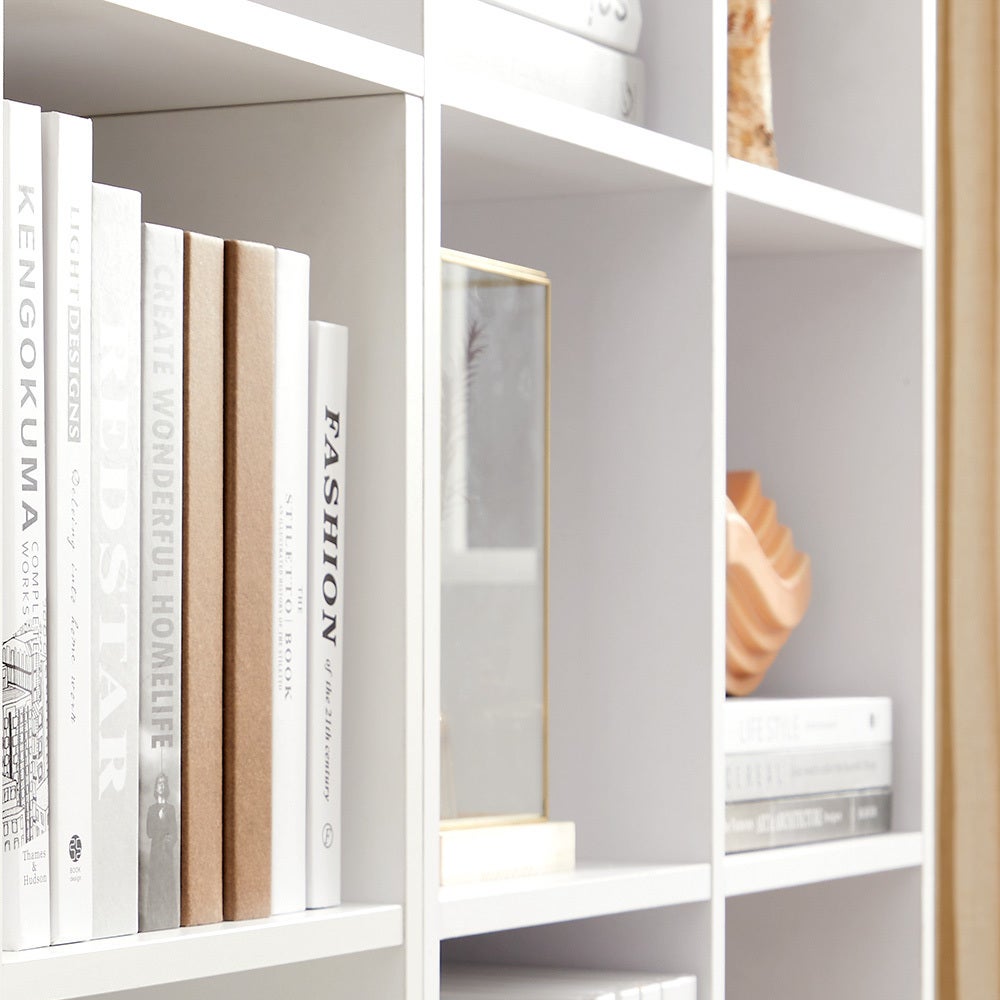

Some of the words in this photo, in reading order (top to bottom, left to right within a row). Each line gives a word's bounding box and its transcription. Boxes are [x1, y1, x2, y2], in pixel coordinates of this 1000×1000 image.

[68, 206, 80, 301] LIGHT
[152, 263, 175, 376] CREATE
[67, 307, 80, 442] DESIGNS
[151, 387, 175, 583] WONDERFUL
[322, 405, 340, 647] FASHION
[22, 541, 30, 615] WORKS
[31, 541, 40, 653] COMPLETE
[150, 594, 175, 749] HOMELIFE
[283, 631, 293, 701] BOOK
[323, 658, 333, 677] of
[324, 680, 332, 704] the
[321, 744, 331, 802] century
[22, 849, 47, 861] Thames
[23, 873, 48, 886] Hudson
